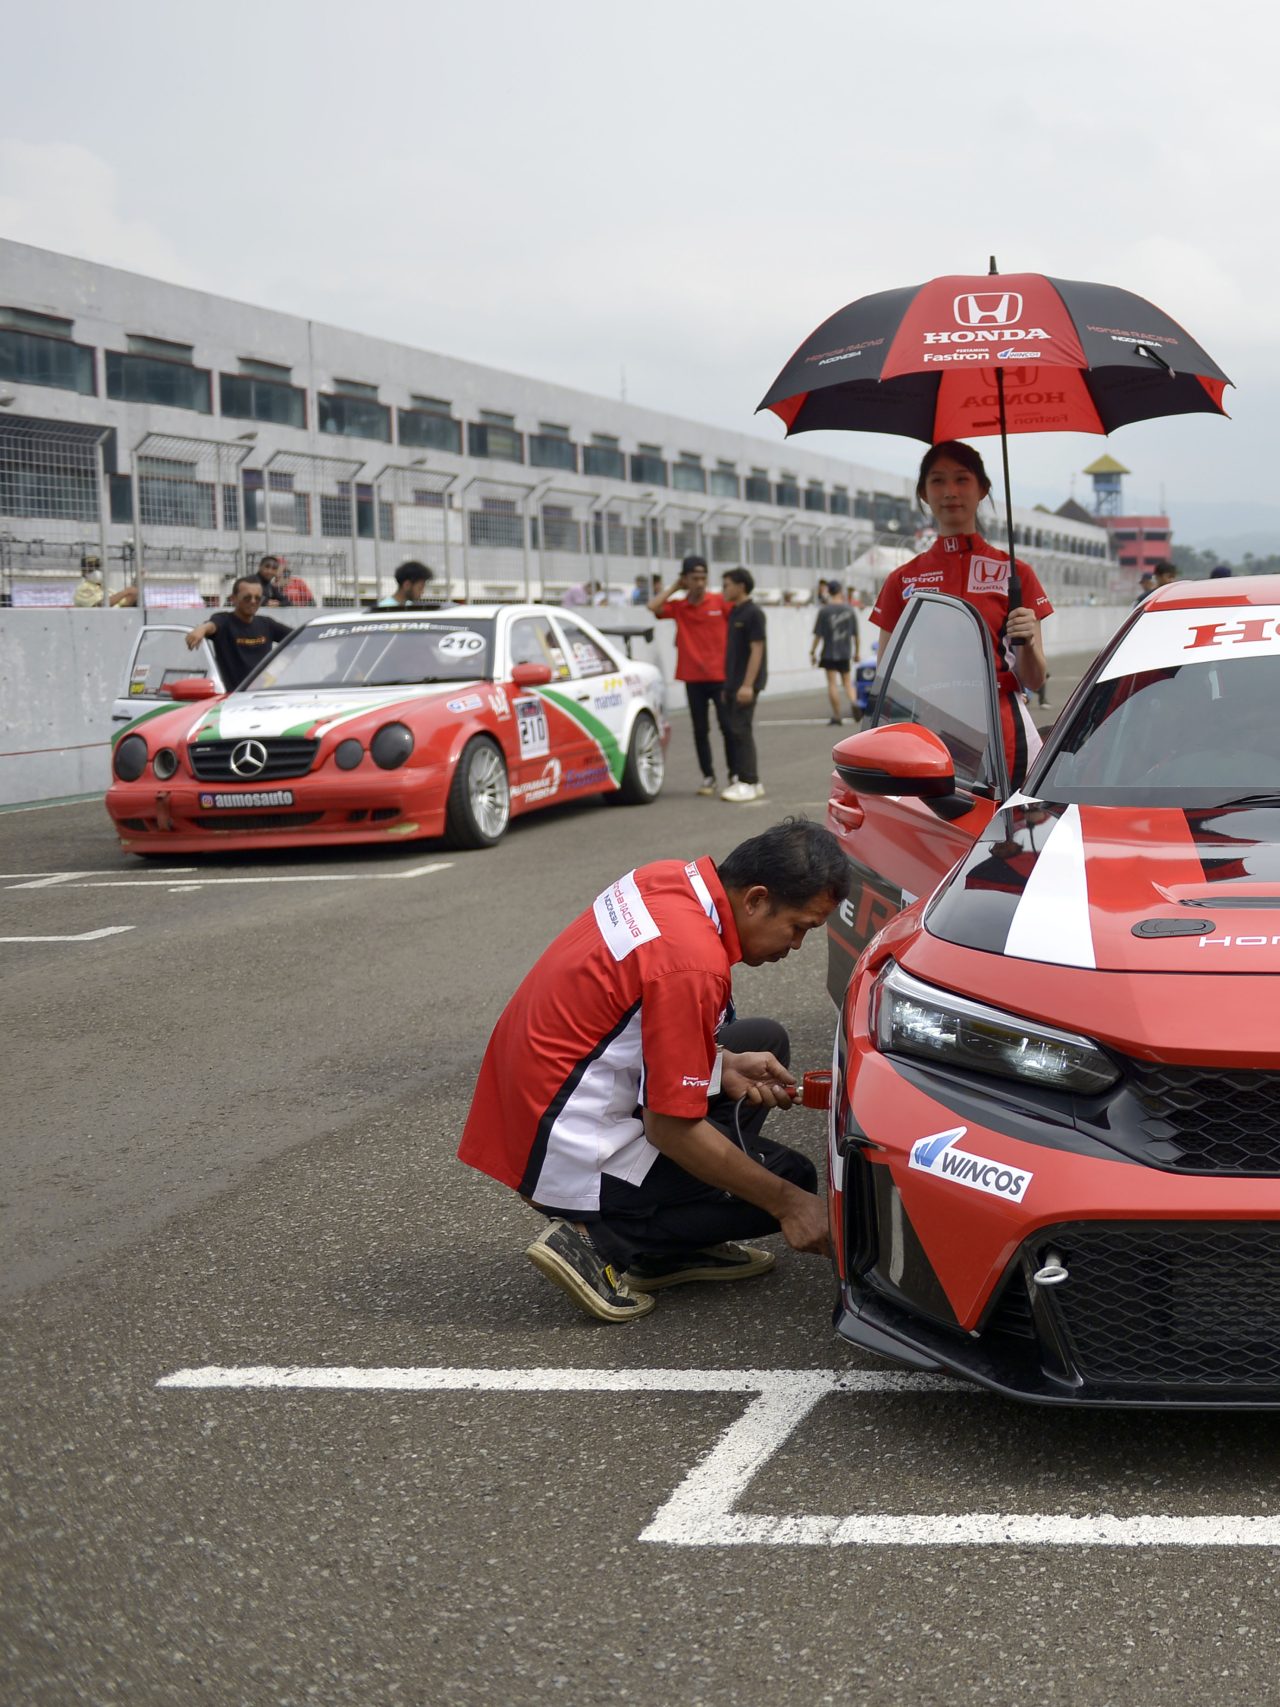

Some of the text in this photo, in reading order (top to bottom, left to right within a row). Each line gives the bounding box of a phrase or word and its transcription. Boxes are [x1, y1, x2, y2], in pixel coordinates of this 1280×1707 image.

[923, 328, 1051, 344] HONDA
[923, 351, 990, 363] Fastron
[440, 637, 483, 650] 210
[520, 718, 546, 745] 210
[215, 790, 293, 808] aumosauto
[619, 903, 642, 938] RACING
[941, 1151, 1026, 1196] WINCOS
